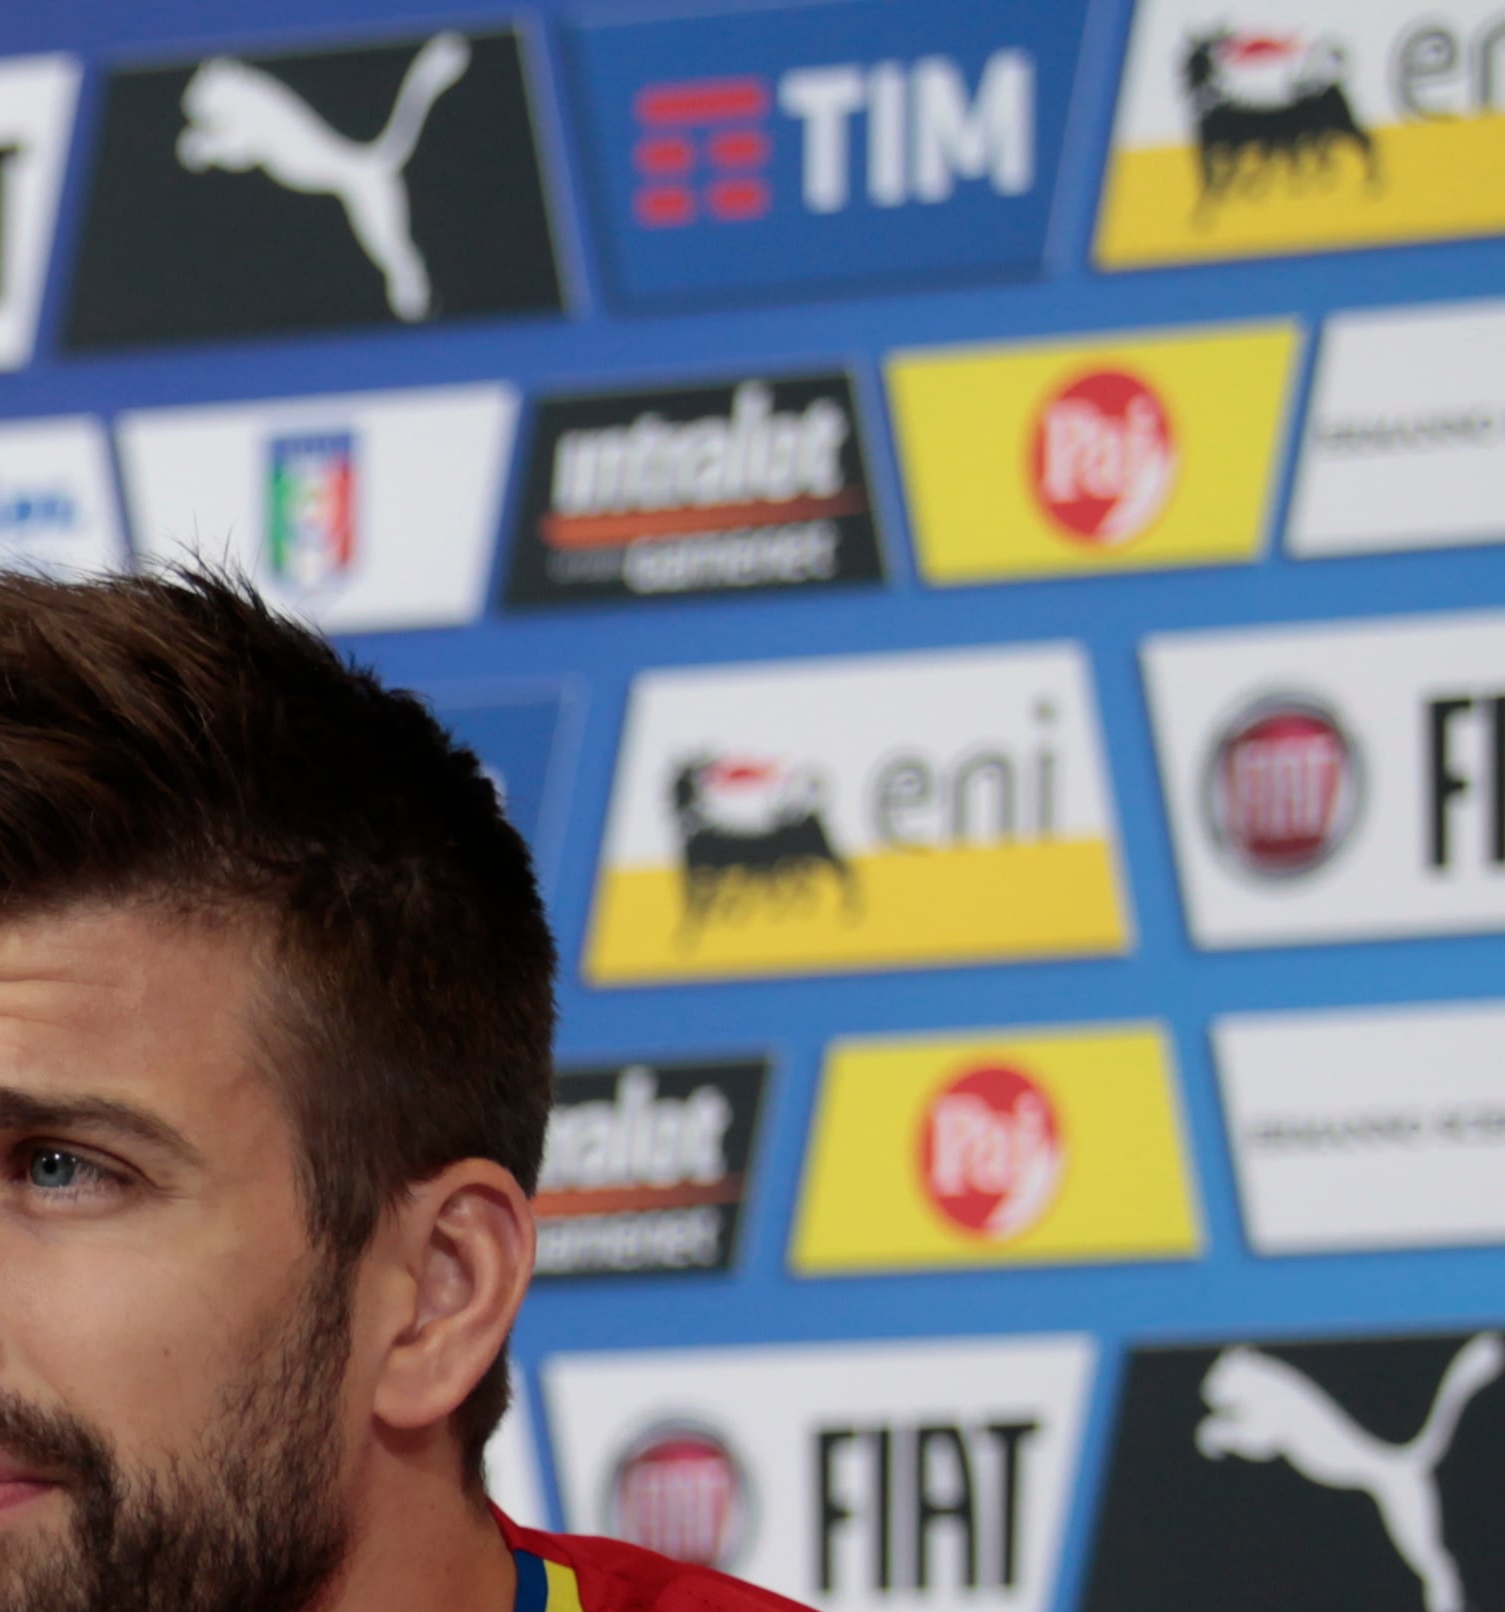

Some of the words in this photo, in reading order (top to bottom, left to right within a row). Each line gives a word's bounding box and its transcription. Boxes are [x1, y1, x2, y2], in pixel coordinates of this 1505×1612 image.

[779, 46, 1034, 213] TIM
[865, 687, 1061, 852] eni
[812, 1418, 1040, 1596] FIAT
